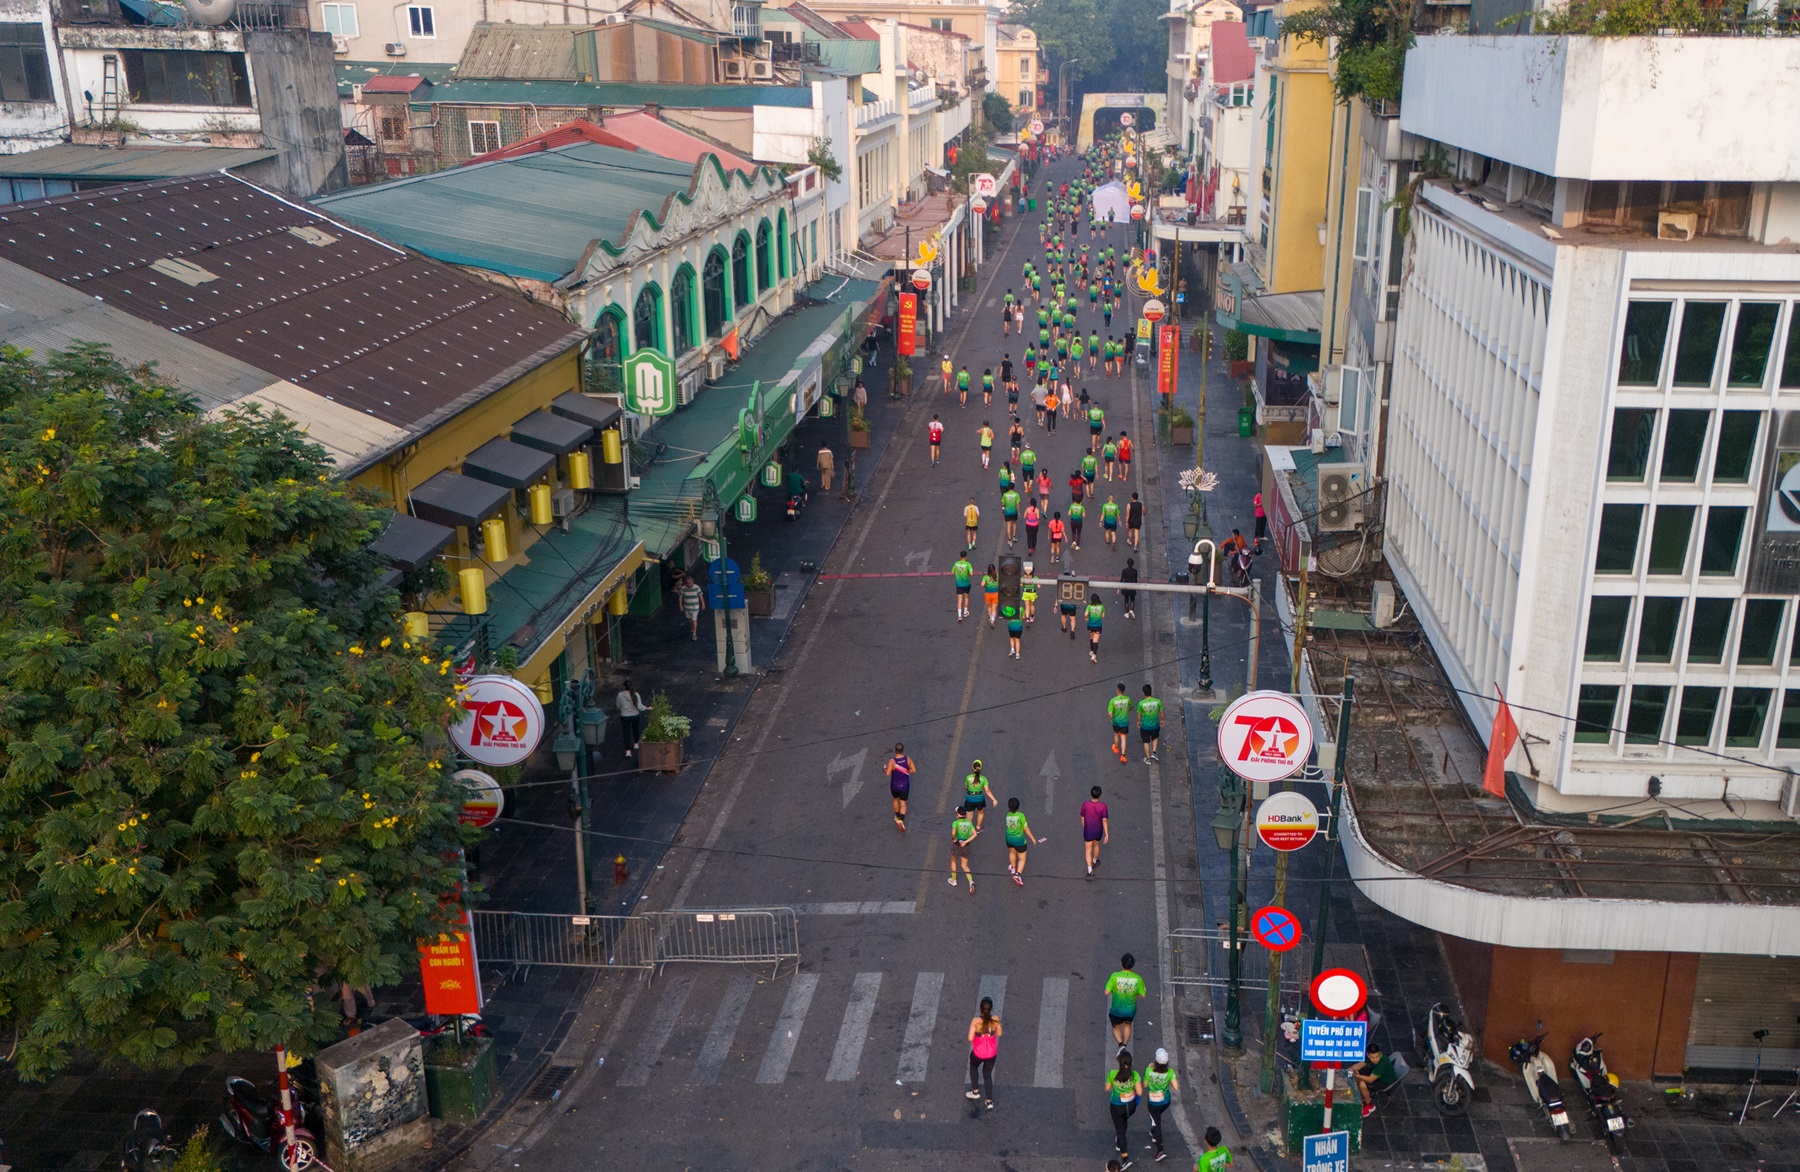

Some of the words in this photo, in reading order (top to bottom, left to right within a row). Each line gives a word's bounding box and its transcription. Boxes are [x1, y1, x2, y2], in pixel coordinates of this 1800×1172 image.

[1267, 815, 1302, 823] HDBank
[429, 958, 442, 967] CON
[1308, 1024, 1329, 1036] TUYẾN
[1330, 1024, 1345, 1036] PHỐ
[1353, 1025, 1363, 1038] BỘ
[1315, 1136, 1338, 1159] NHẬN
